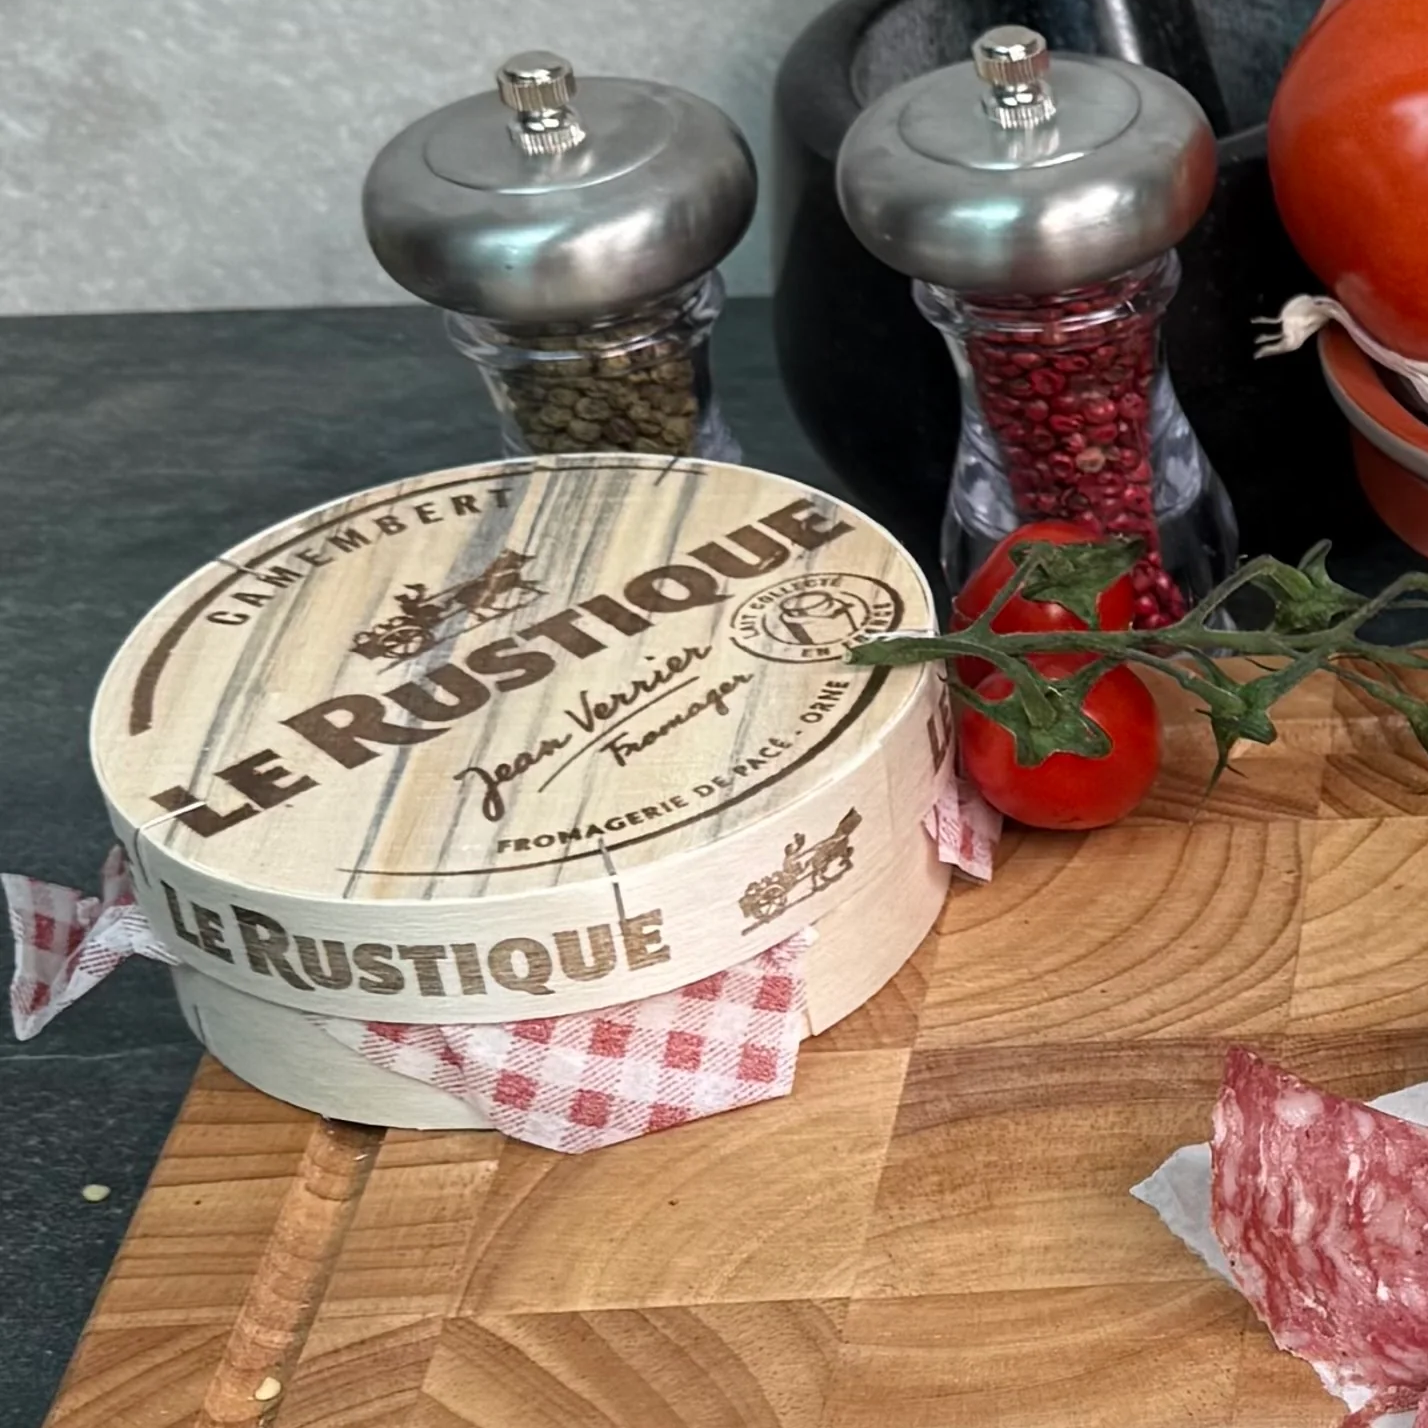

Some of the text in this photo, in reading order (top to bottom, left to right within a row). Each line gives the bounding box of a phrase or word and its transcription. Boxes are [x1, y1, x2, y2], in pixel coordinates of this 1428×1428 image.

[206, 487, 513, 627] CAMEMBERT
[149, 498, 856, 838] LE RUSTIQUE
[740, 614, 761, 640] LAIT
[801, 646, 830, 658] EN
[453, 643, 714, 822] Jean Verrier
[496, 794, 690, 854] FROMAGERIE
[692, 775, 728, 800] DE
[799, 680, 850, 724] ORNE
[600, 671, 755, 767] Fromager
[161, 879, 671, 998] LE RUSTIQUE
